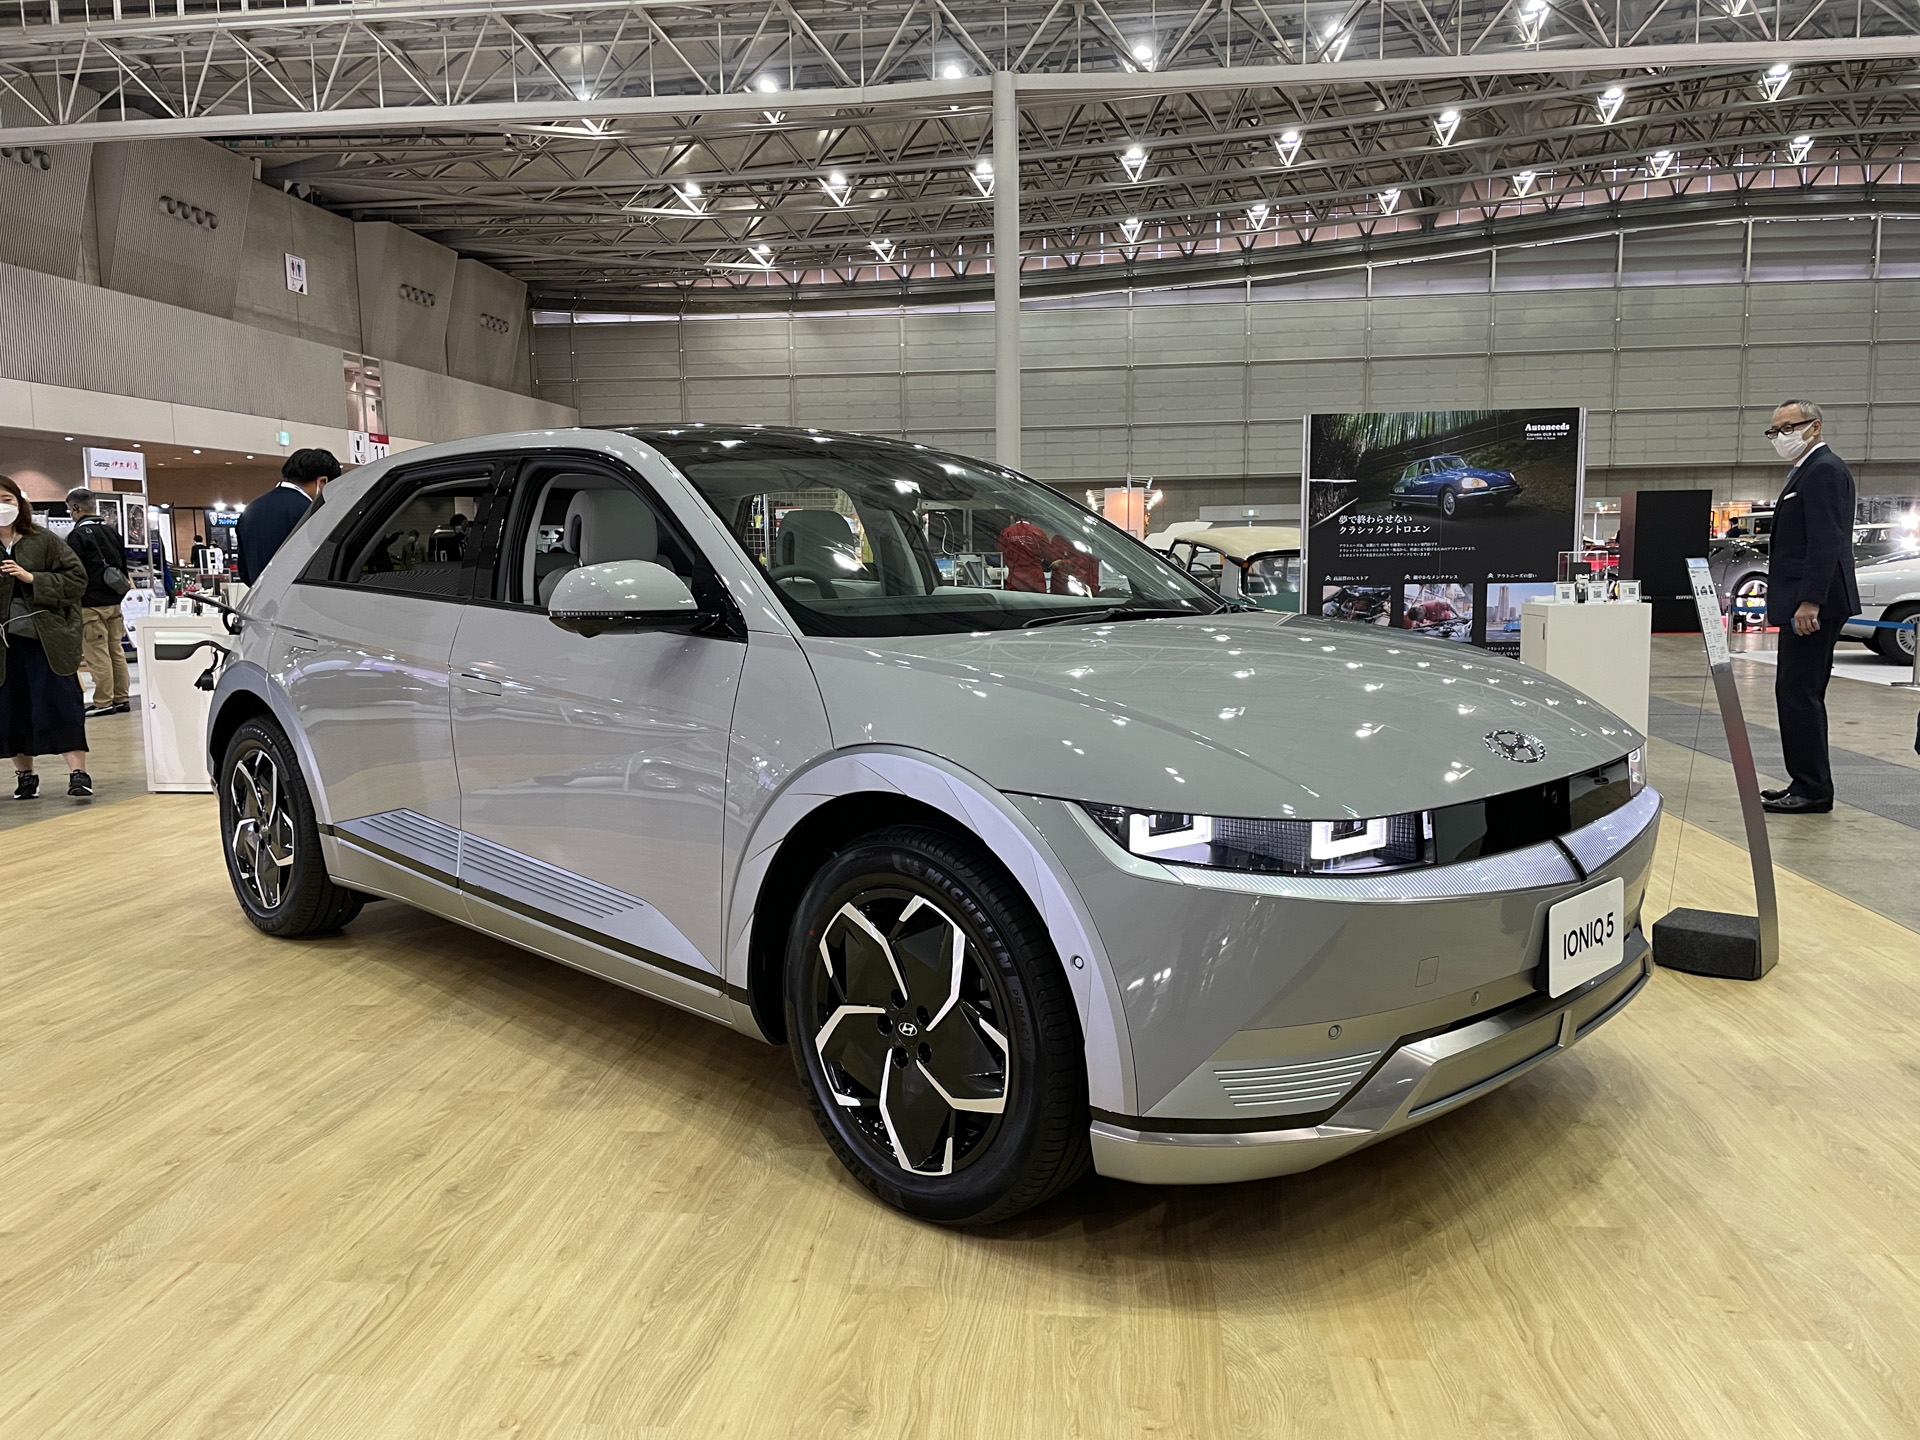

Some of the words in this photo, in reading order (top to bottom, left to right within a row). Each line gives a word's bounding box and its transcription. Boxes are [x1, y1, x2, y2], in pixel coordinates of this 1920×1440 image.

[1525, 422, 1570, 431] Autoneeds
[374, 445, 386, 460] 11
[1339, 514, 1413, 525] 夢で終わらせない
[1339, 525, 1431, 535] クラシックシトロエン
[925, 868, 1013, 970] MICHELIN
[1563, 917, 1604, 960] IONIQ
[1606, 911, 1614, 938] 5
